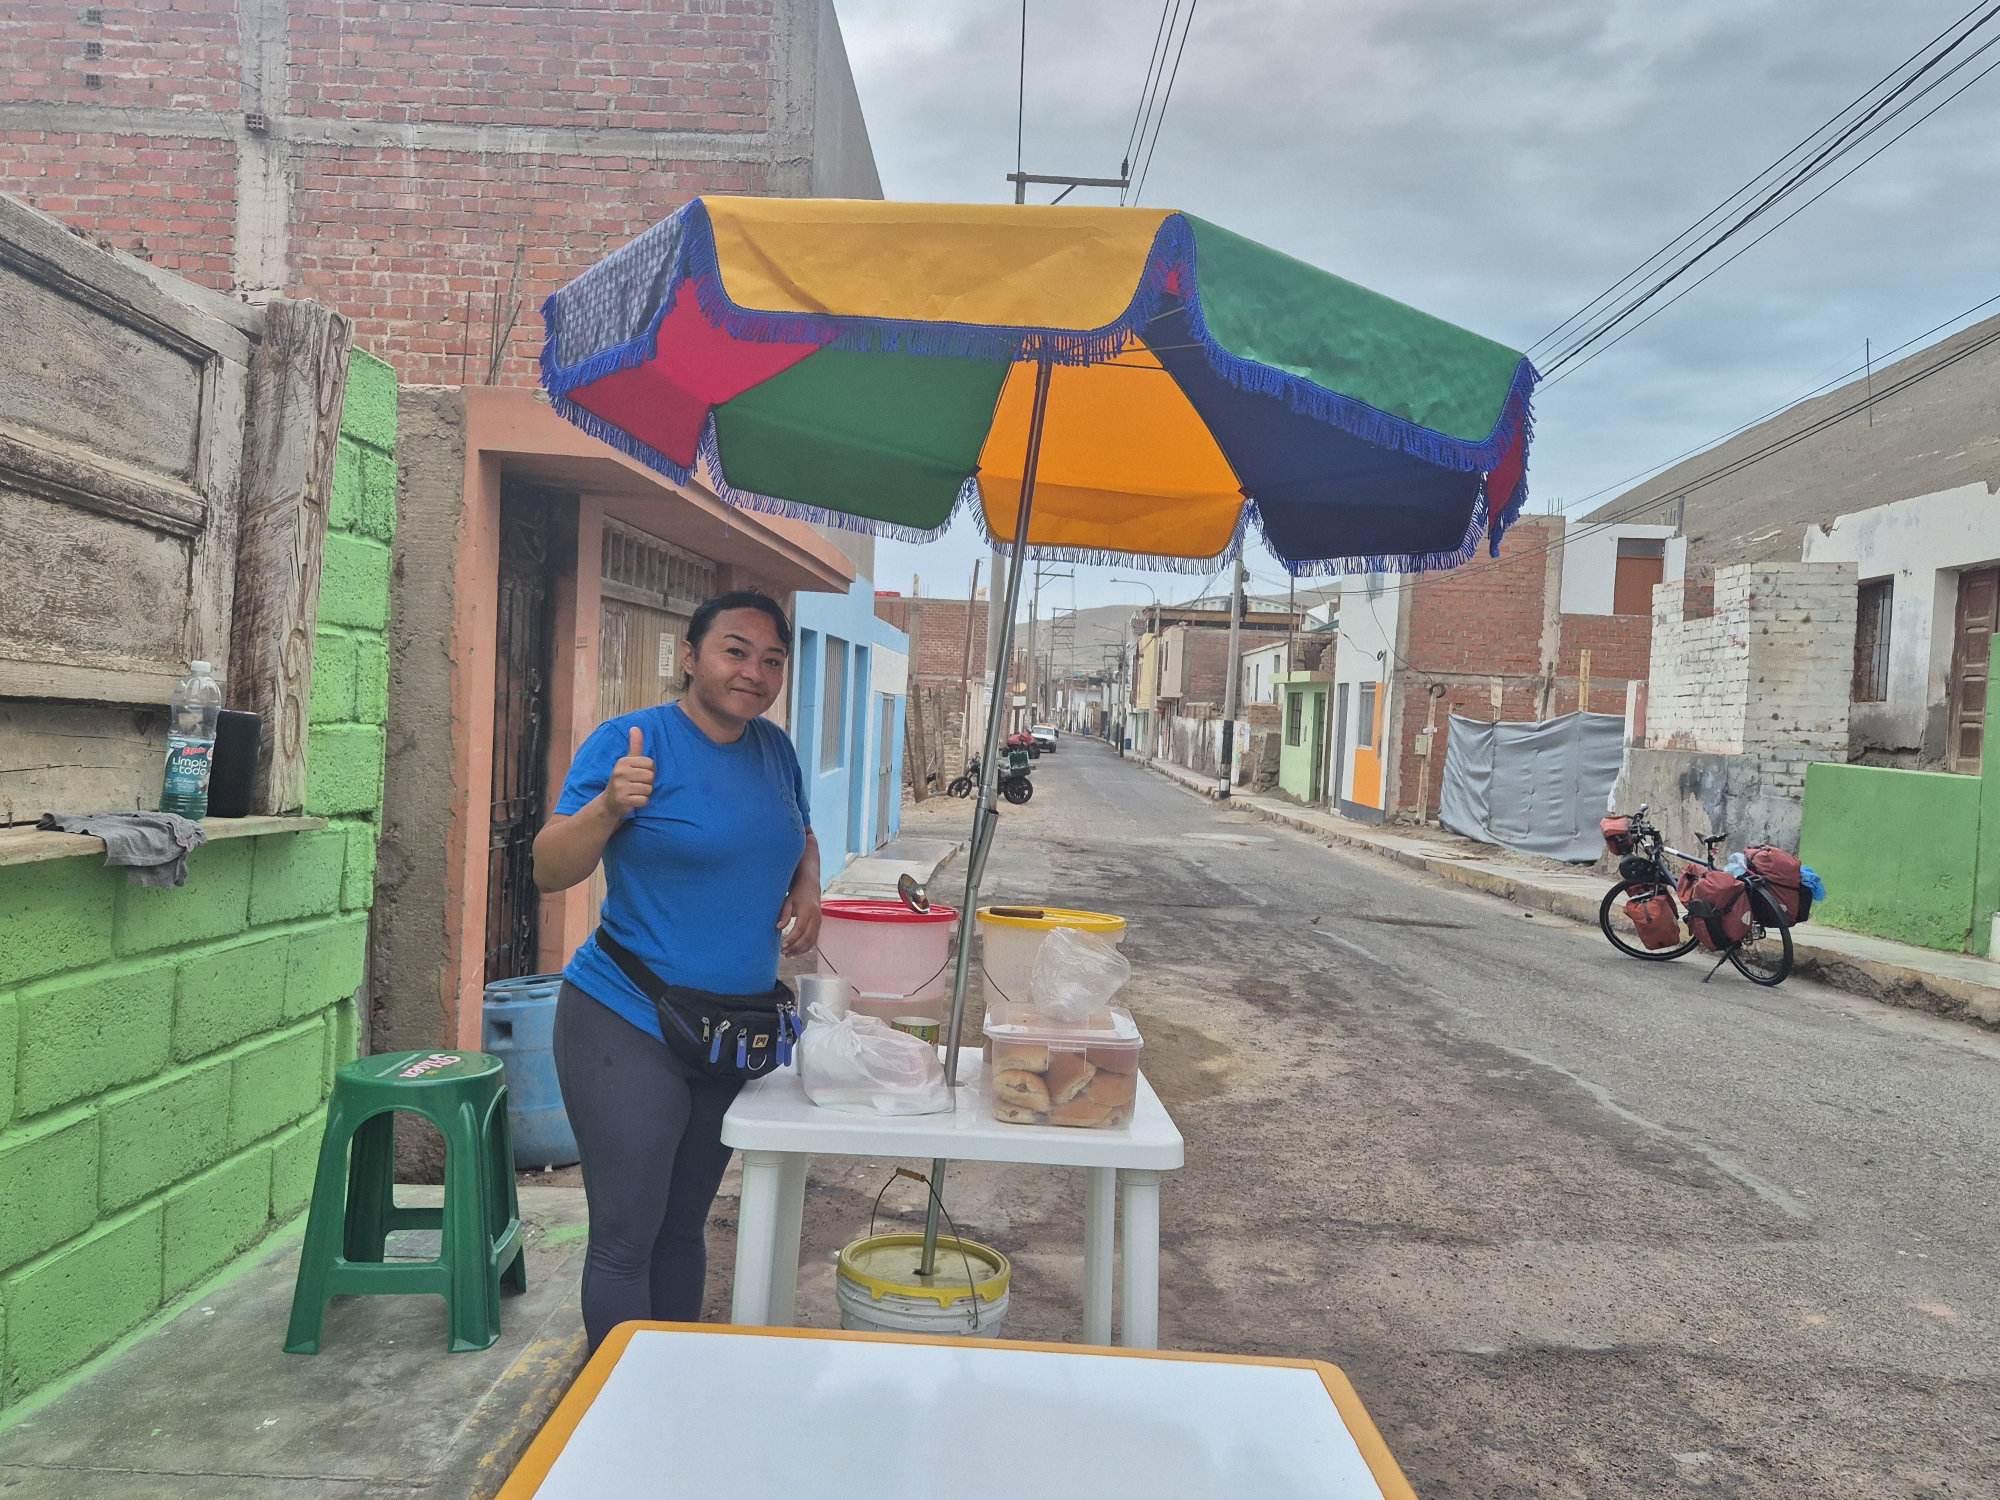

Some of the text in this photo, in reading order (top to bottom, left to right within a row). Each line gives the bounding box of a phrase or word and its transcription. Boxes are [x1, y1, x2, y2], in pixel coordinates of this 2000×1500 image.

[172, 756, 207, 768] Limpia
[179, 765, 207, 776] todo
[397, 1053, 462, 1078] Pilsen
